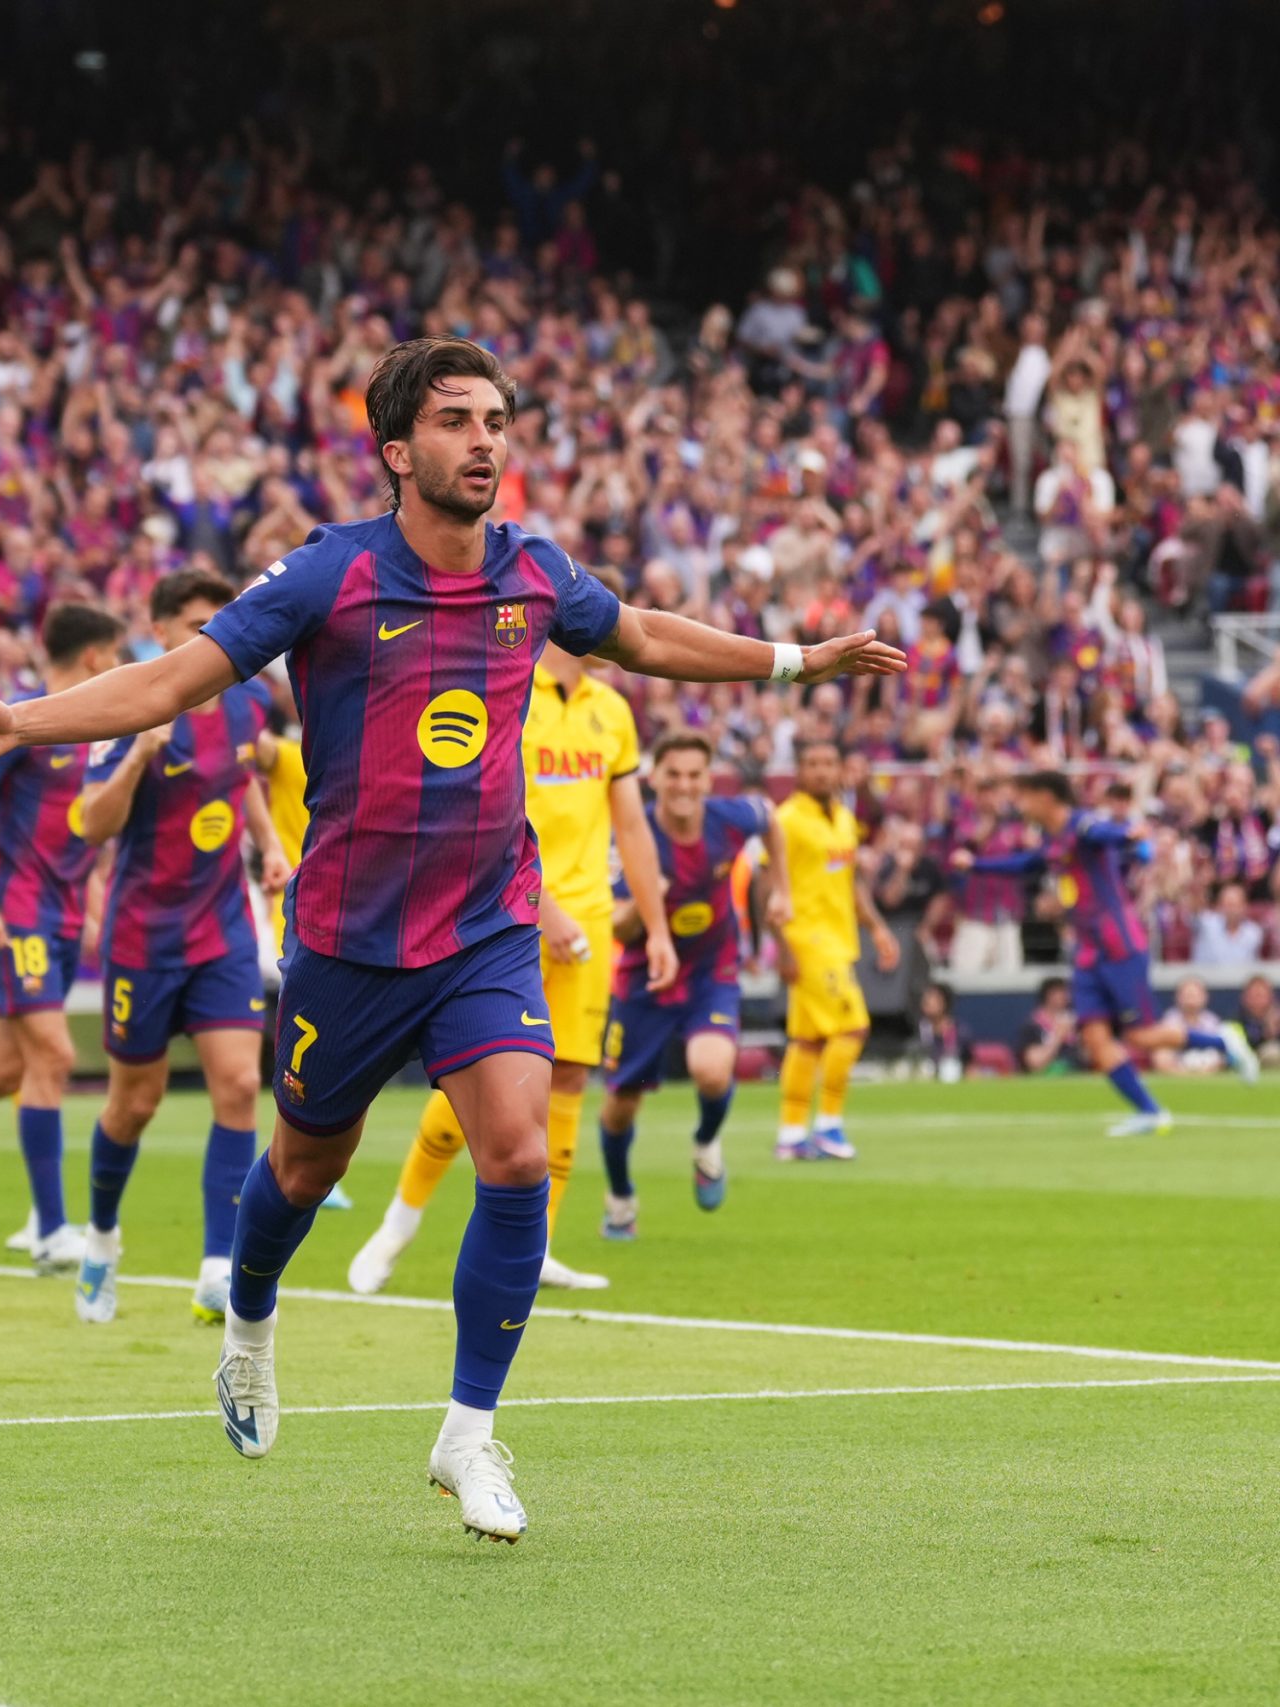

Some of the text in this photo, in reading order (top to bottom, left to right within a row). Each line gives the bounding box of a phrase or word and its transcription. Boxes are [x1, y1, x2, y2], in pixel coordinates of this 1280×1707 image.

[537, 746, 604, 782] DANI
[11, 934, 50, 977] 18
[113, 977, 133, 1023] 5
[291, 1014, 319, 1074] 7
